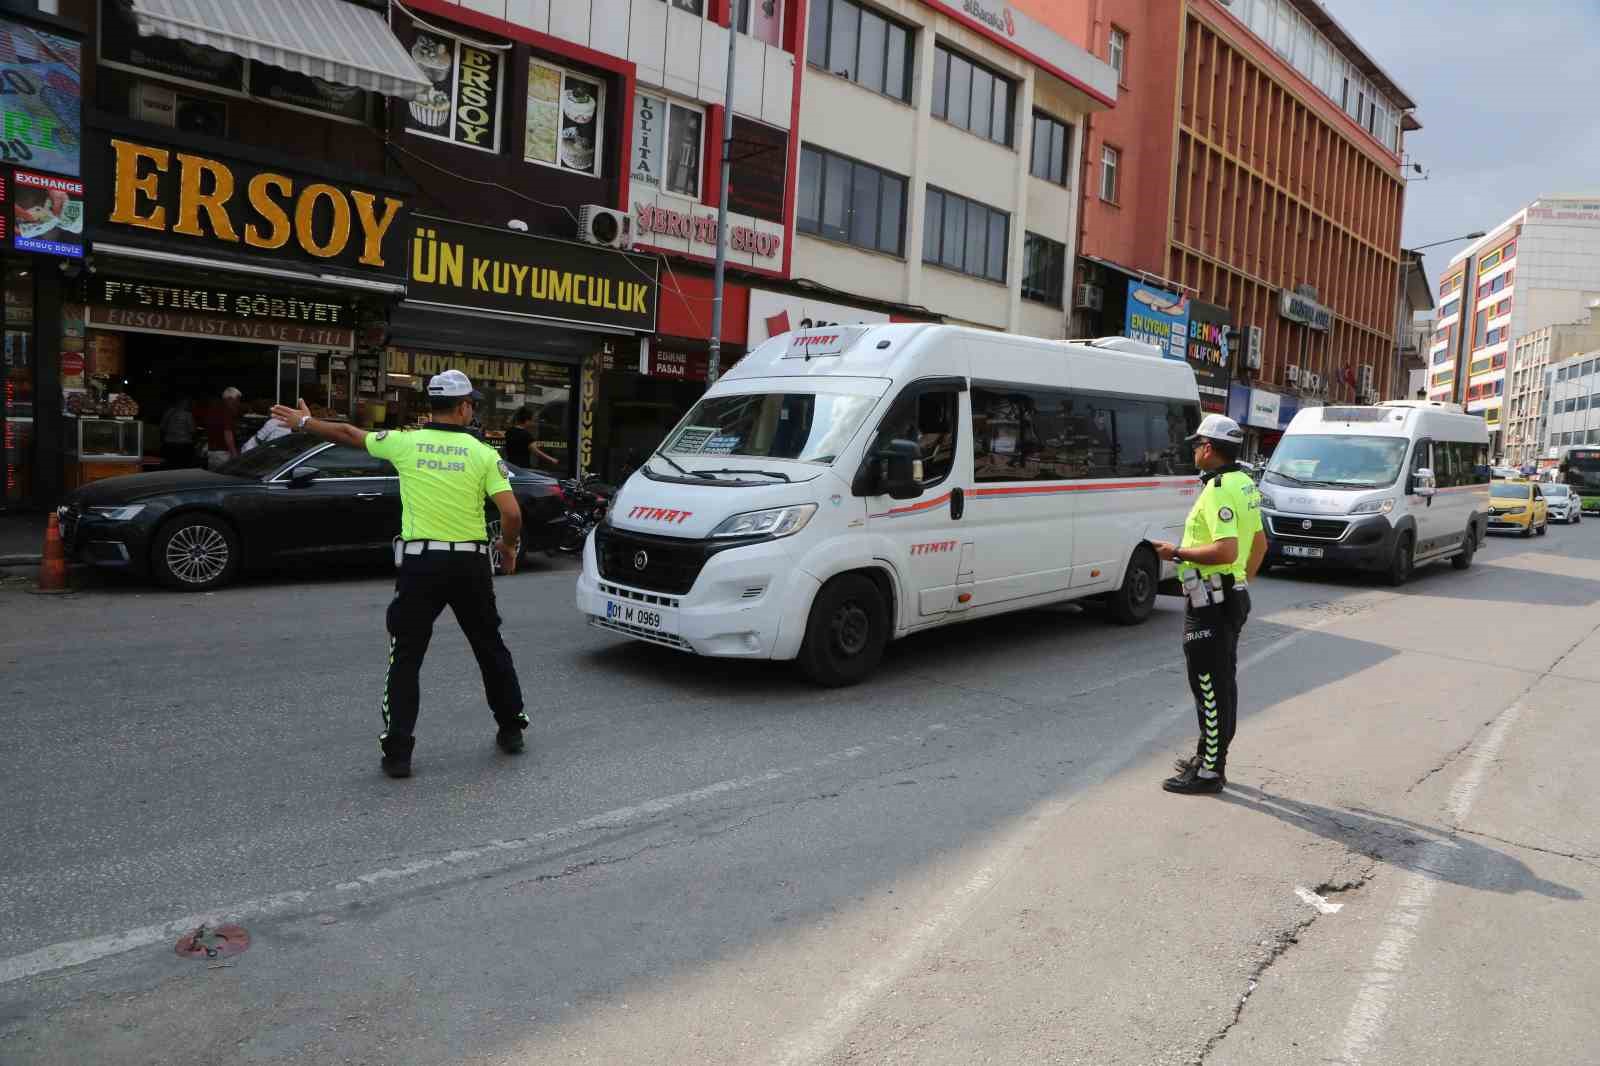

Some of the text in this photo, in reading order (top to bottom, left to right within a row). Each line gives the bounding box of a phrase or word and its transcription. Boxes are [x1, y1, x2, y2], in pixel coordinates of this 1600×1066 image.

[458, 49, 490, 145] ERSOY
[15, 173, 83, 193] EXCHANGE
[109, 138, 404, 267] ERSOY
[412, 228, 649, 314] ÜN KUYUMCULUK
[732, 225, 781, 258] SHOP
[612, 604, 661, 628] 01 M 0969
